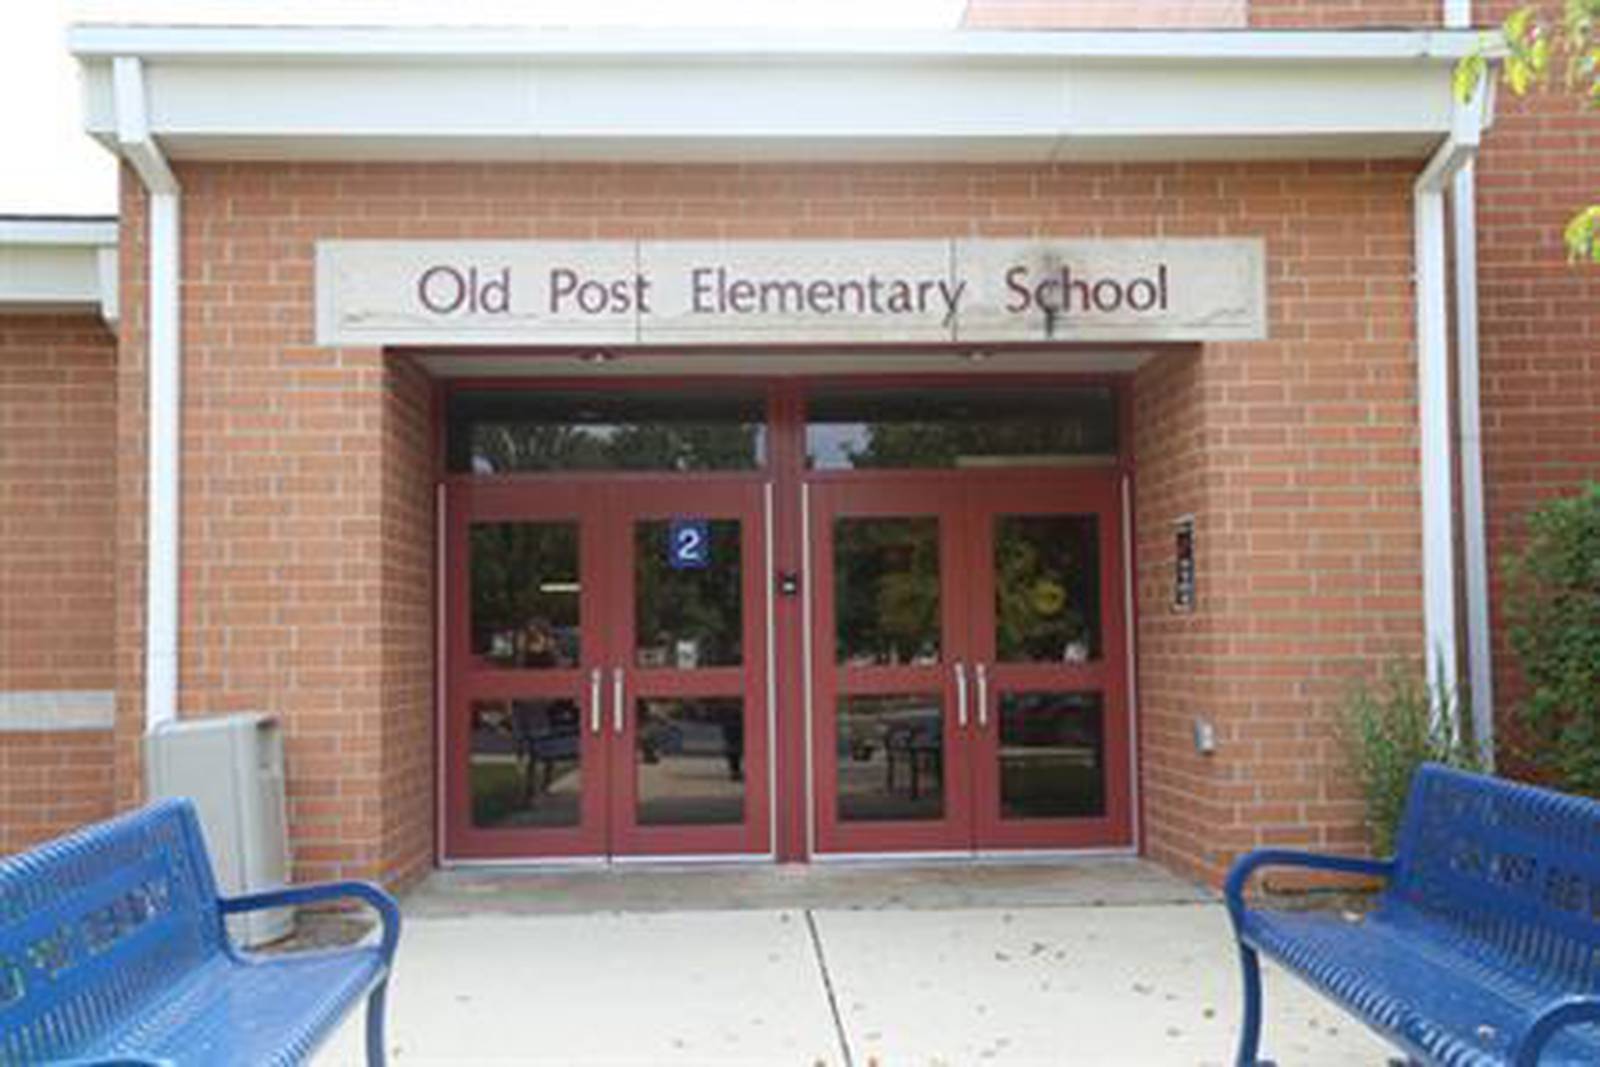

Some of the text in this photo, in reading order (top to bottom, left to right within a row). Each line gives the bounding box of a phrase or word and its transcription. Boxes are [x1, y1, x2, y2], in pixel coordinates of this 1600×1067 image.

[418, 264, 1168, 329] Old Post Elementary School
[677, 528, 700, 560] 2
